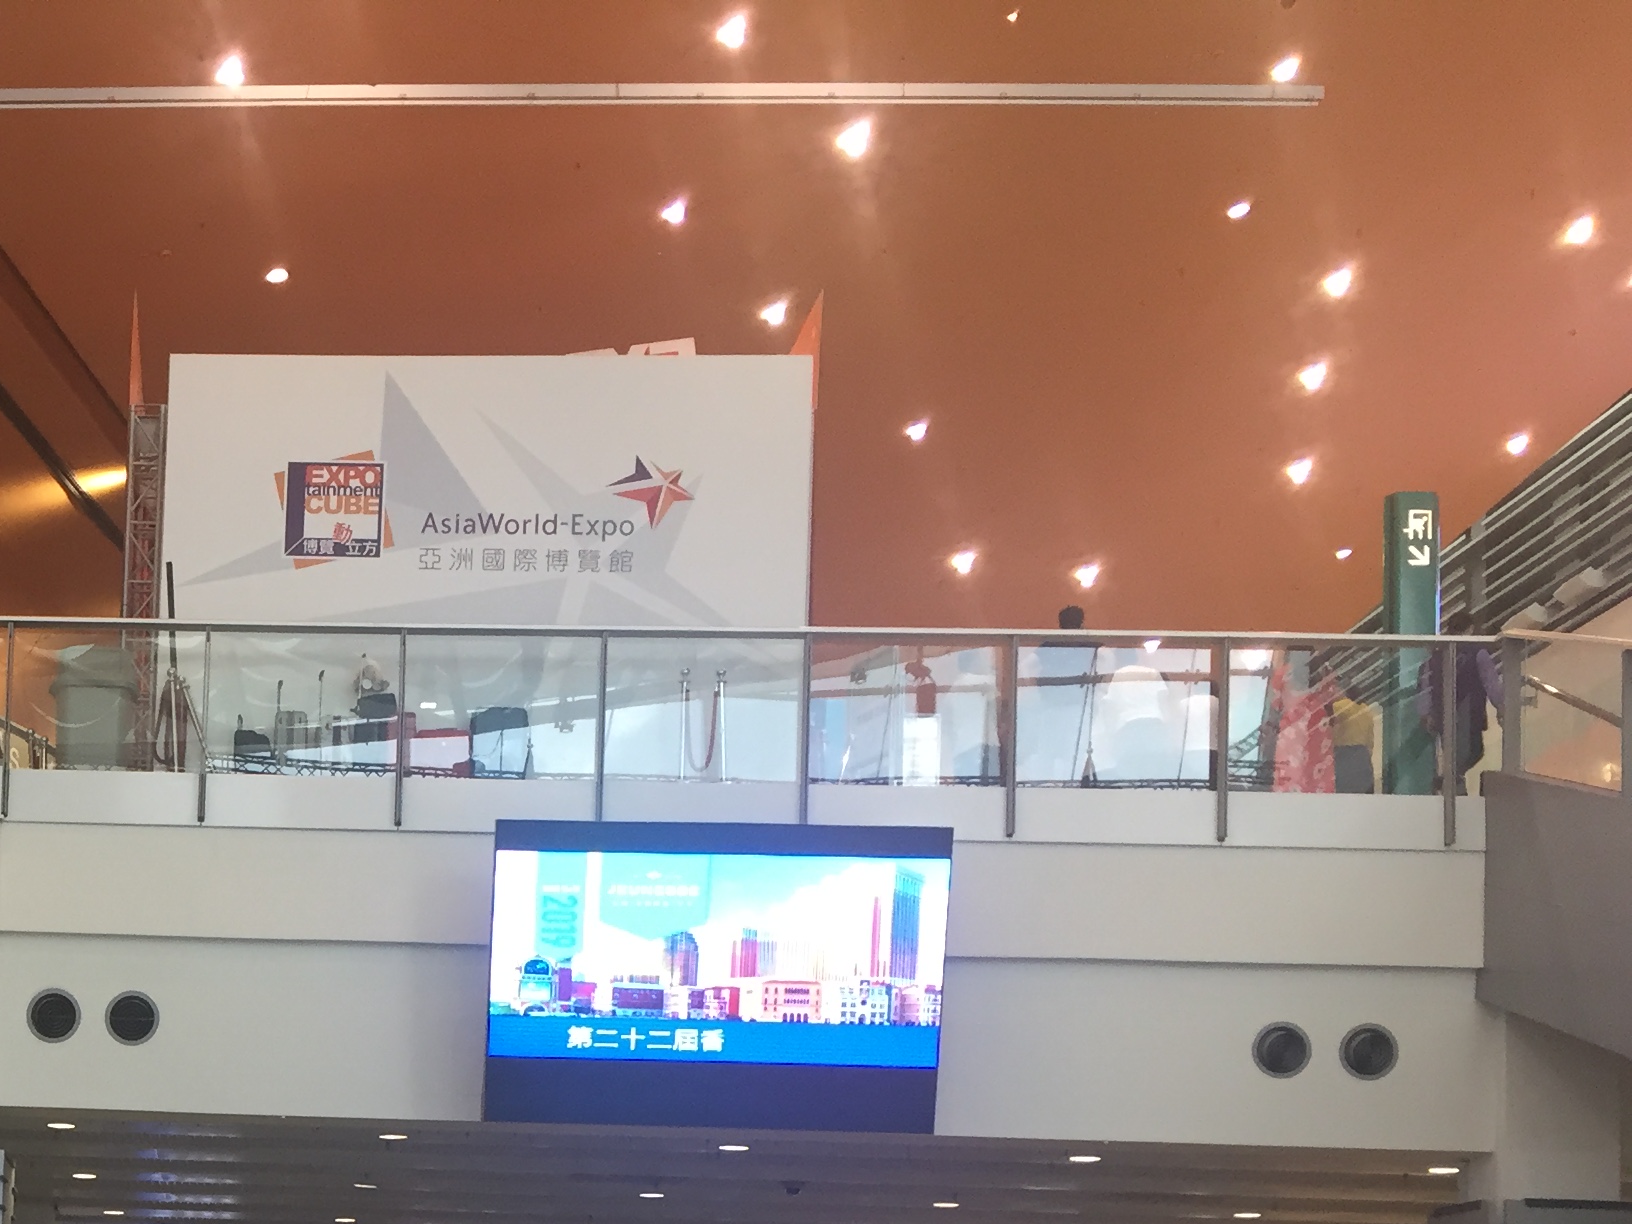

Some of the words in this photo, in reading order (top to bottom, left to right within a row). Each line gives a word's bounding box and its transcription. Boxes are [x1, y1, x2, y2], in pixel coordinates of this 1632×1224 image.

[306, 465, 382, 488] EXPO
[305, 483, 381, 497] tainment
[304, 494, 380, 515] CUBE
[421, 512, 636, 541] AsiaWorld-Expo
[418, 547, 634, 574] 亞洲國際博覽館
[566, 1026, 725, 1053] 第二十二屆香
